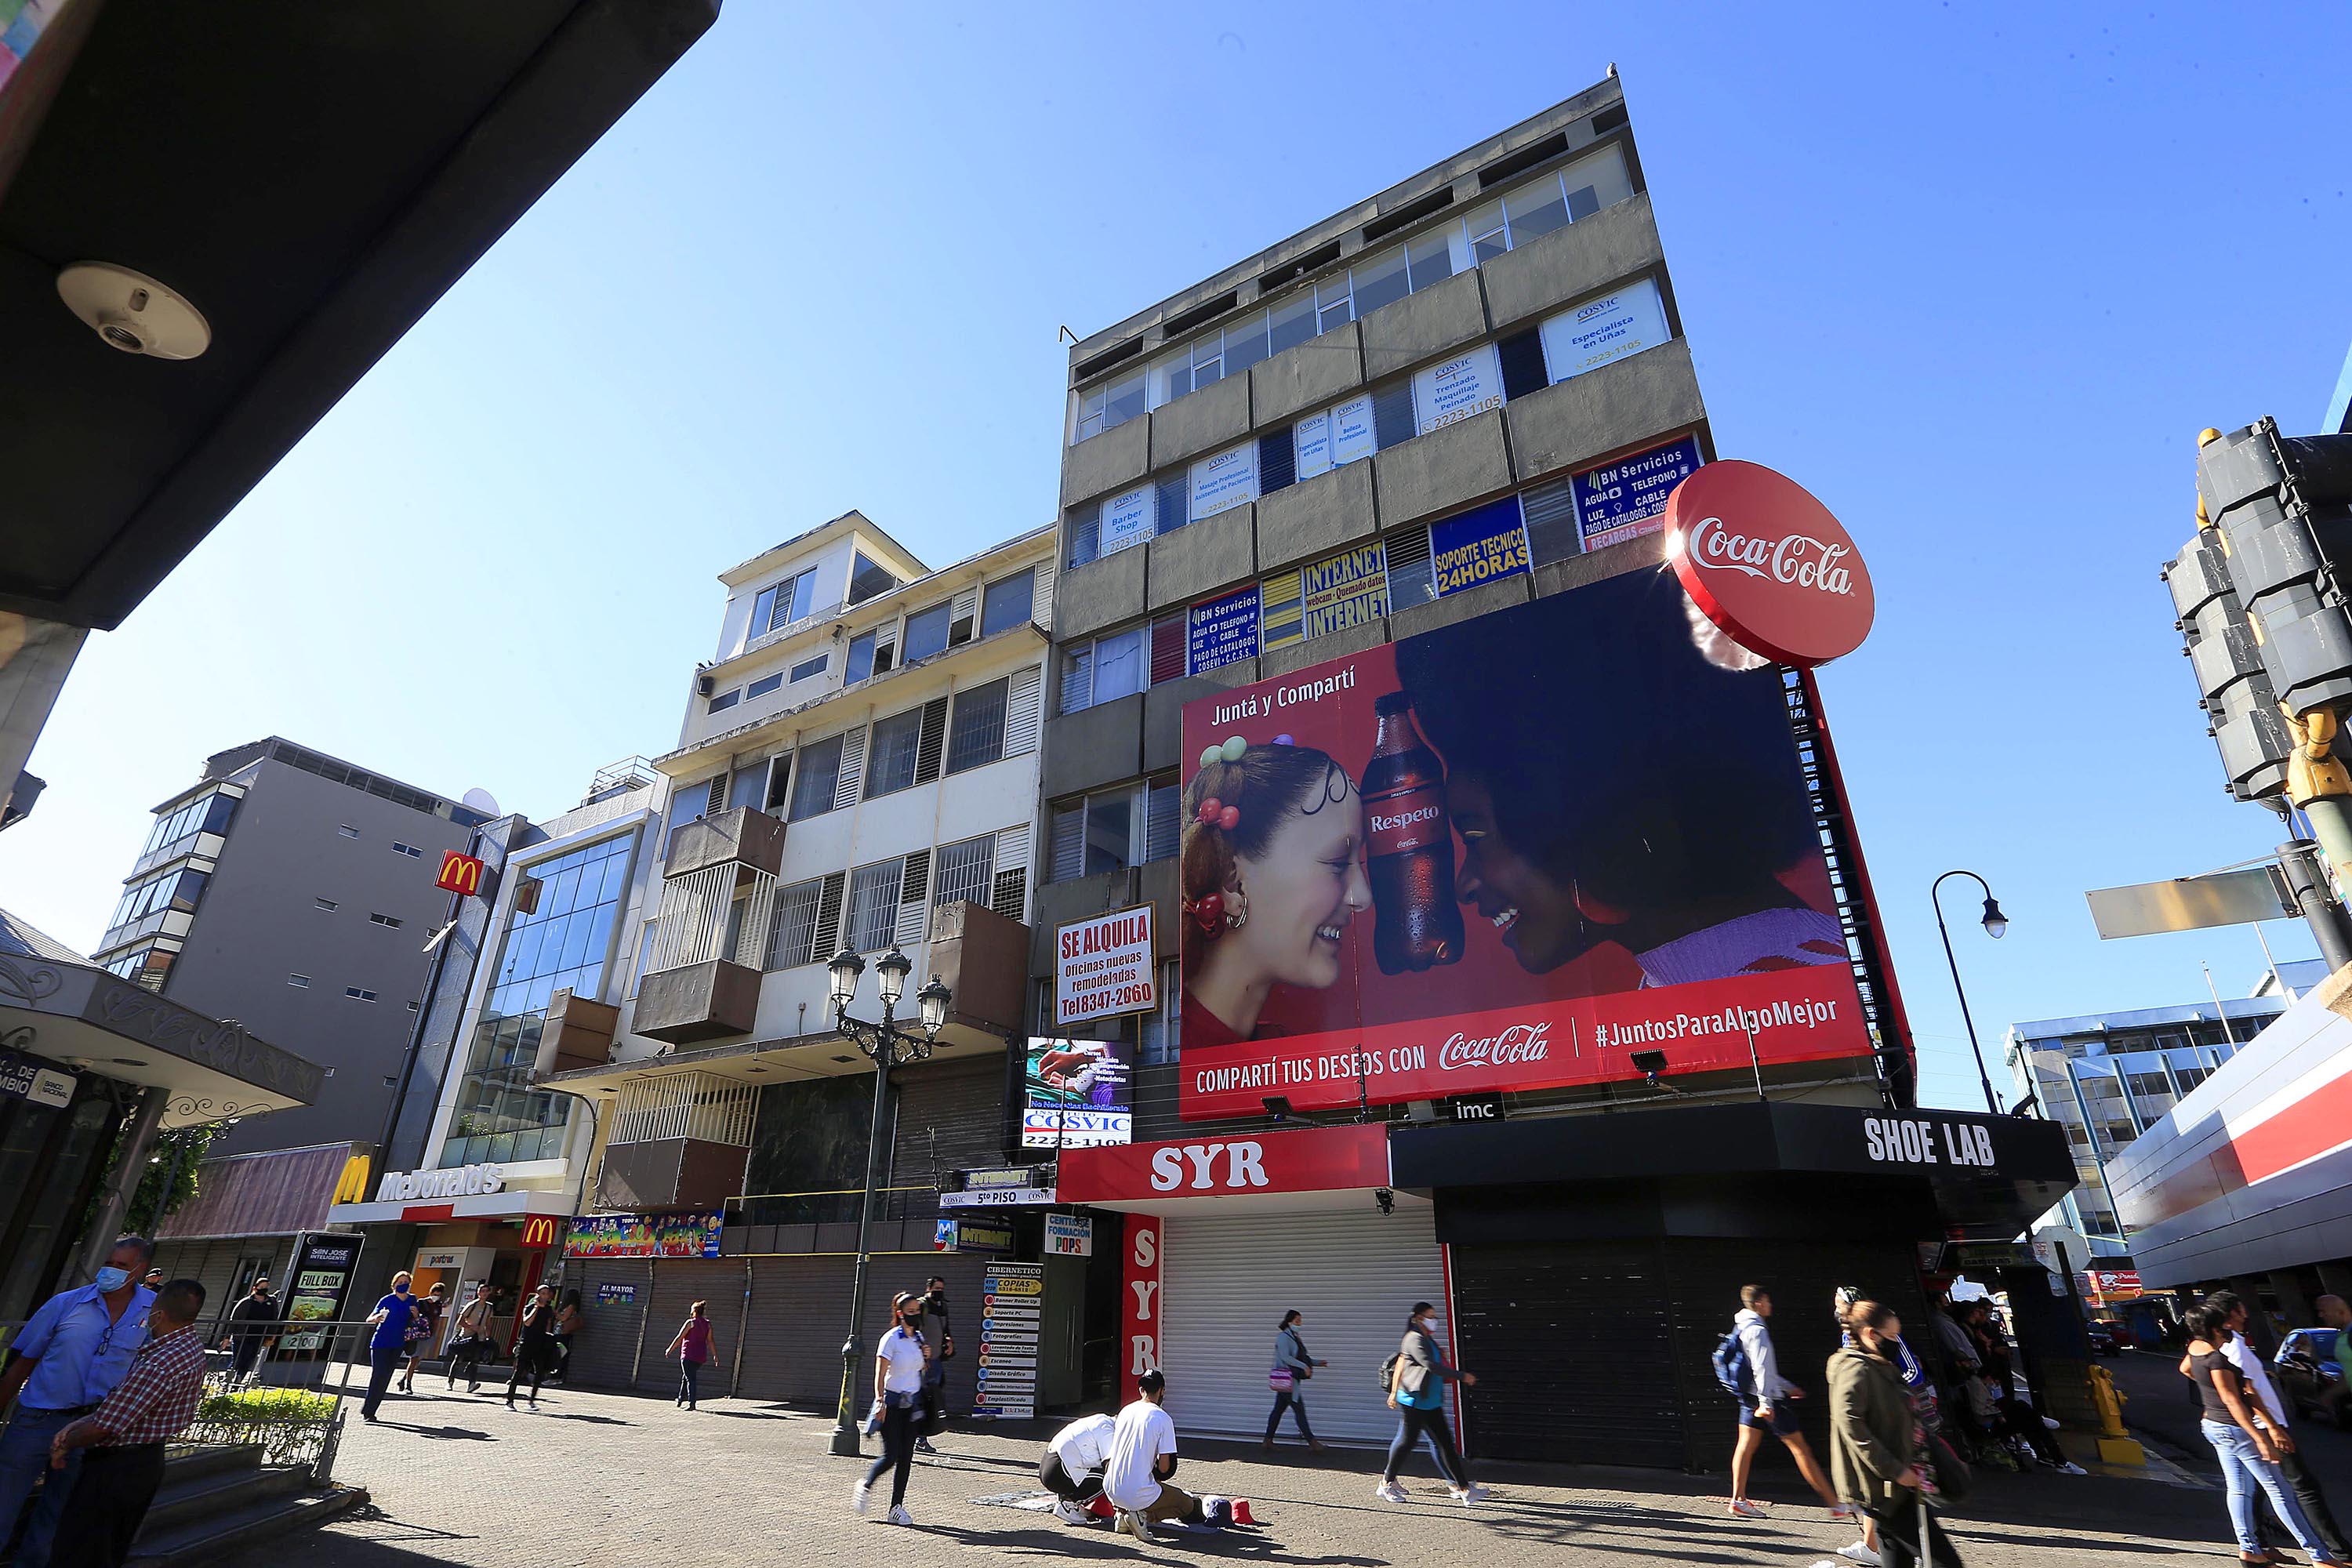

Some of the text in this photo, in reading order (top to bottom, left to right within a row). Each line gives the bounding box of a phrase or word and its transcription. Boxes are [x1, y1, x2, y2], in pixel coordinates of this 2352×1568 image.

[1577, 296, 1618, 318] COSVIC
[1572, 316, 1634, 345] Especialista
[1583, 328, 1626, 350] en Uñas
[1586, 339, 1641, 366] 2223-1105
[1436, 358, 1472, 376] COSVIC
[1434, 382, 1479, 404] Maquillaje
[1436, 376, 1475, 394] Trenzado
[1338, 401, 1364, 415] COSVIC
[1434, 395, 1501, 429] 2223-1105
[1441, 394, 1475, 411] Peinado
[1299, 416, 1325, 430] COSVIC
[1343, 423, 1361, 434] Belleza
[1299, 437, 1327, 452] Especialista
[1338, 428, 1367, 443] Profesional
[1208, 451, 1239, 468] COSVIC
[1311, 445, 1323, 455] Uñas
[1600, 451, 1682, 485] BN Servicios
[1195, 488, 1219, 501] Asistente
[1228, 474, 1254, 488] Pacientes
[1199, 467, 1249, 491] Masaje Profesional
[1632, 470, 1677, 492] TELEFONO
[1114, 491, 1142, 506] COSVIC
[1208, 492, 1248, 513] 2223-1105
[1584, 492, 1608, 506] AGUA
[1635, 489, 1667, 506] CABLE
[1112, 510, 1143, 527] Barber
[1585, 499, 1668, 535] PAGO DE CATALOGOS COSE
[1587, 509, 1606, 522] LUZ
[1115, 520, 1138, 534] Shop
[1109, 528, 1152, 554] 2223-1105
[1591, 526, 1638, 550] RECARGAS
[1436, 527, 1525, 573] SOPORTE TECNICO
[1689, 517, 1853, 596] Coca-Cola
[1305, 541, 1385, 596] INTERNET
[1438, 546, 1529, 593] 24HORAS
[1306, 575, 1386, 608] webcam Quemado datos
[1200, 596, 1257, 622] BN Servicios
[1307, 590, 1388, 640] INTERNET
[1220, 614, 1248, 630] TELEFONO
[1192, 627, 1208, 639] AGUA
[1220, 628, 1240, 641] CABLE
[1192, 640, 1204, 650] LUZ
[1193, 635, 1255, 663] PAGO DE CATALOGOS
[1198, 648, 1251, 672] COSEVI C.C.S.S.
[1211, 665, 1356, 726] Juntá y Compartí
[1370, 805, 1440, 833] Respeto
[1062, 915, 1149, 960] SE ALQUILA
[1065, 951, 1142, 978] Oficinas nuevas
[1072, 968, 1136, 993] remodeladas
[1062, 996, 1080, 1017] Tel
[1595, 998, 1837, 1047] #JuntosParaAlgoMejor
[1196, 1021, 1553, 1094] COMPARTÍ TUS DESEOS CON Coca-Cola
[17, 1065, 36, 1080] DE
[42, 1087, 68, 1099] NACIONAL
[45, 1080, 63, 1091] BANCO
[1456, 1101, 1494, 1120] imc
[1025, 1114, 1130, 1131] COSVIC
[1025, 1135, 1128, 1147] 2223-1105
[1864, 1117, 1995, 1167] SHOE LAB
[1150, 1140, 1269, 1192] SYR
[376, 1163, 503, 1203] McDonald's
[969, 1170, 1029, 1185] INTERNET
[978, 1192, 991, 1203] 5to
[993, 1192, 1017, 1203] PISO
[1047, 1226, 1091, 1238] FORMACIÓN
[1055, 1236, 1082, 1254] POPS
[301, 1275, 341, 1287] FULL BOX
